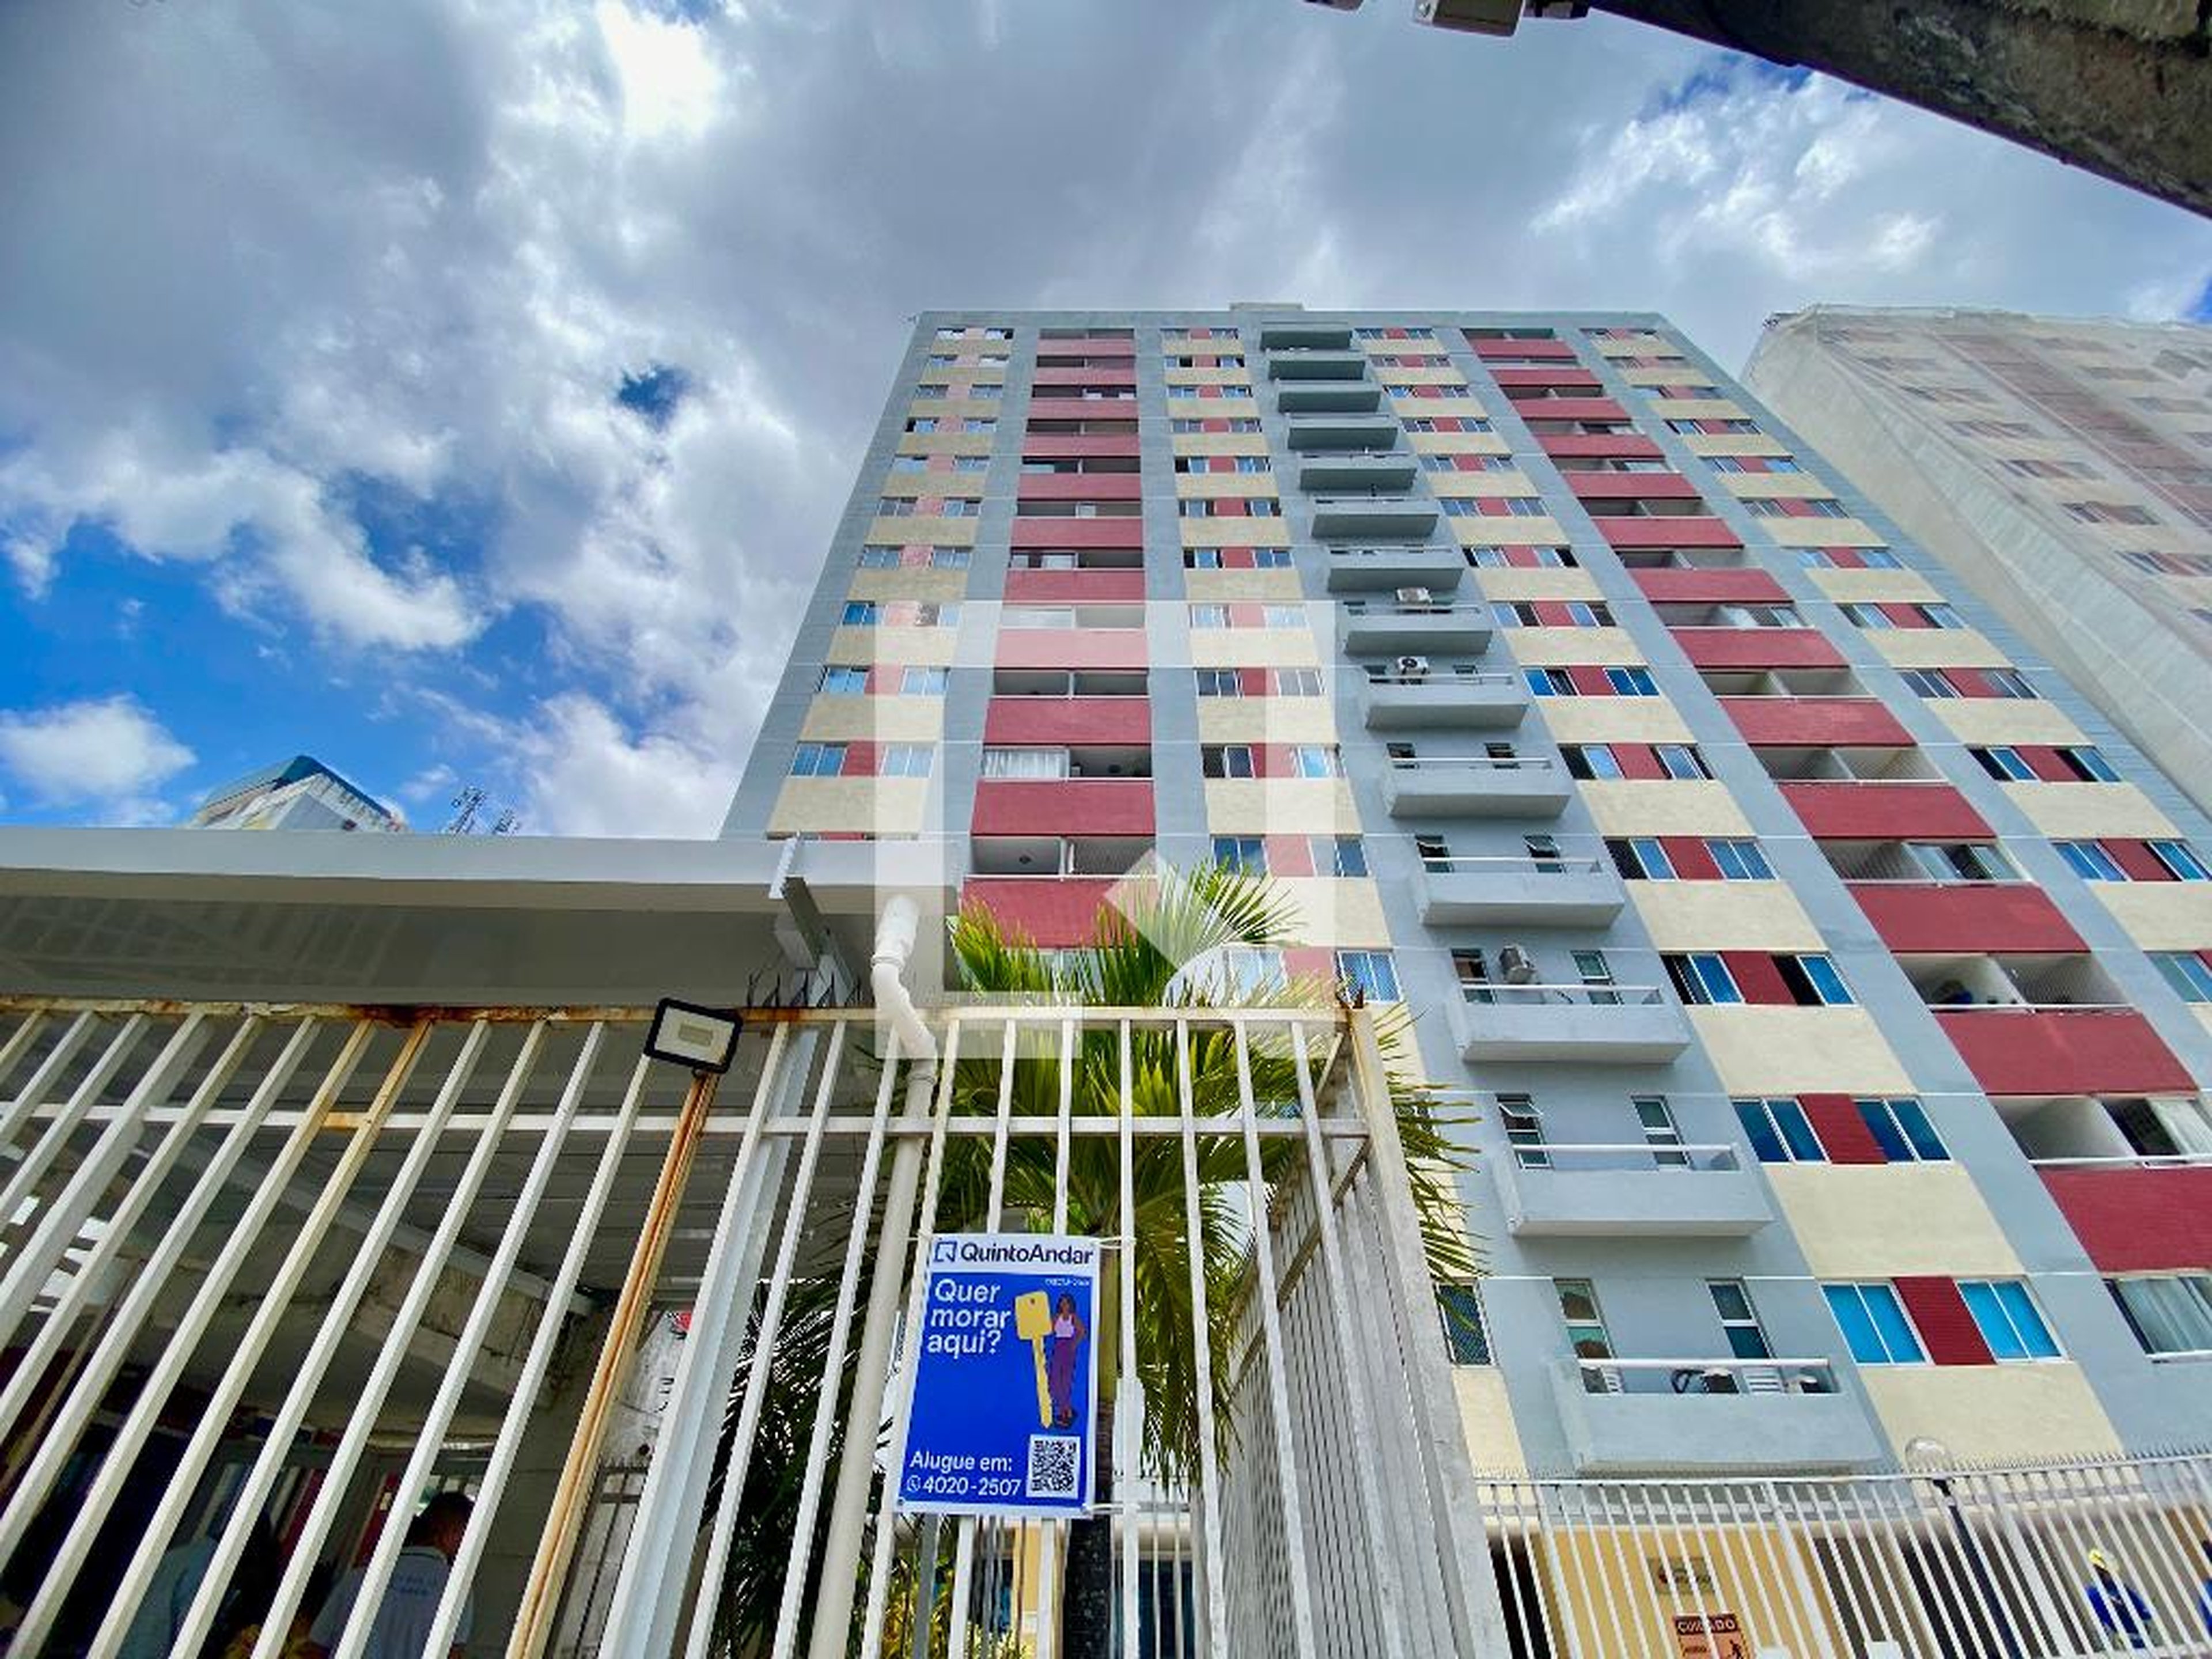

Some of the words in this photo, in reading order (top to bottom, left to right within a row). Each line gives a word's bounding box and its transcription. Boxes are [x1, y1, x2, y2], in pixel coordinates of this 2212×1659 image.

[961, 1243, 1093, 1264] QuintoAndar
[935, 1278, 1001, 1303] Quer
[931, 1309, 1011, 1328] morar
[927, 1329, 1001, 1359] aqui?
[909, 1450, 975, 1474] Alugue
[980, 1457, 1012, 1472] em:
[923, 1475, 1021, 1496] 4020-2507
[1678, 1619, 1736, 1633] CUIDO
